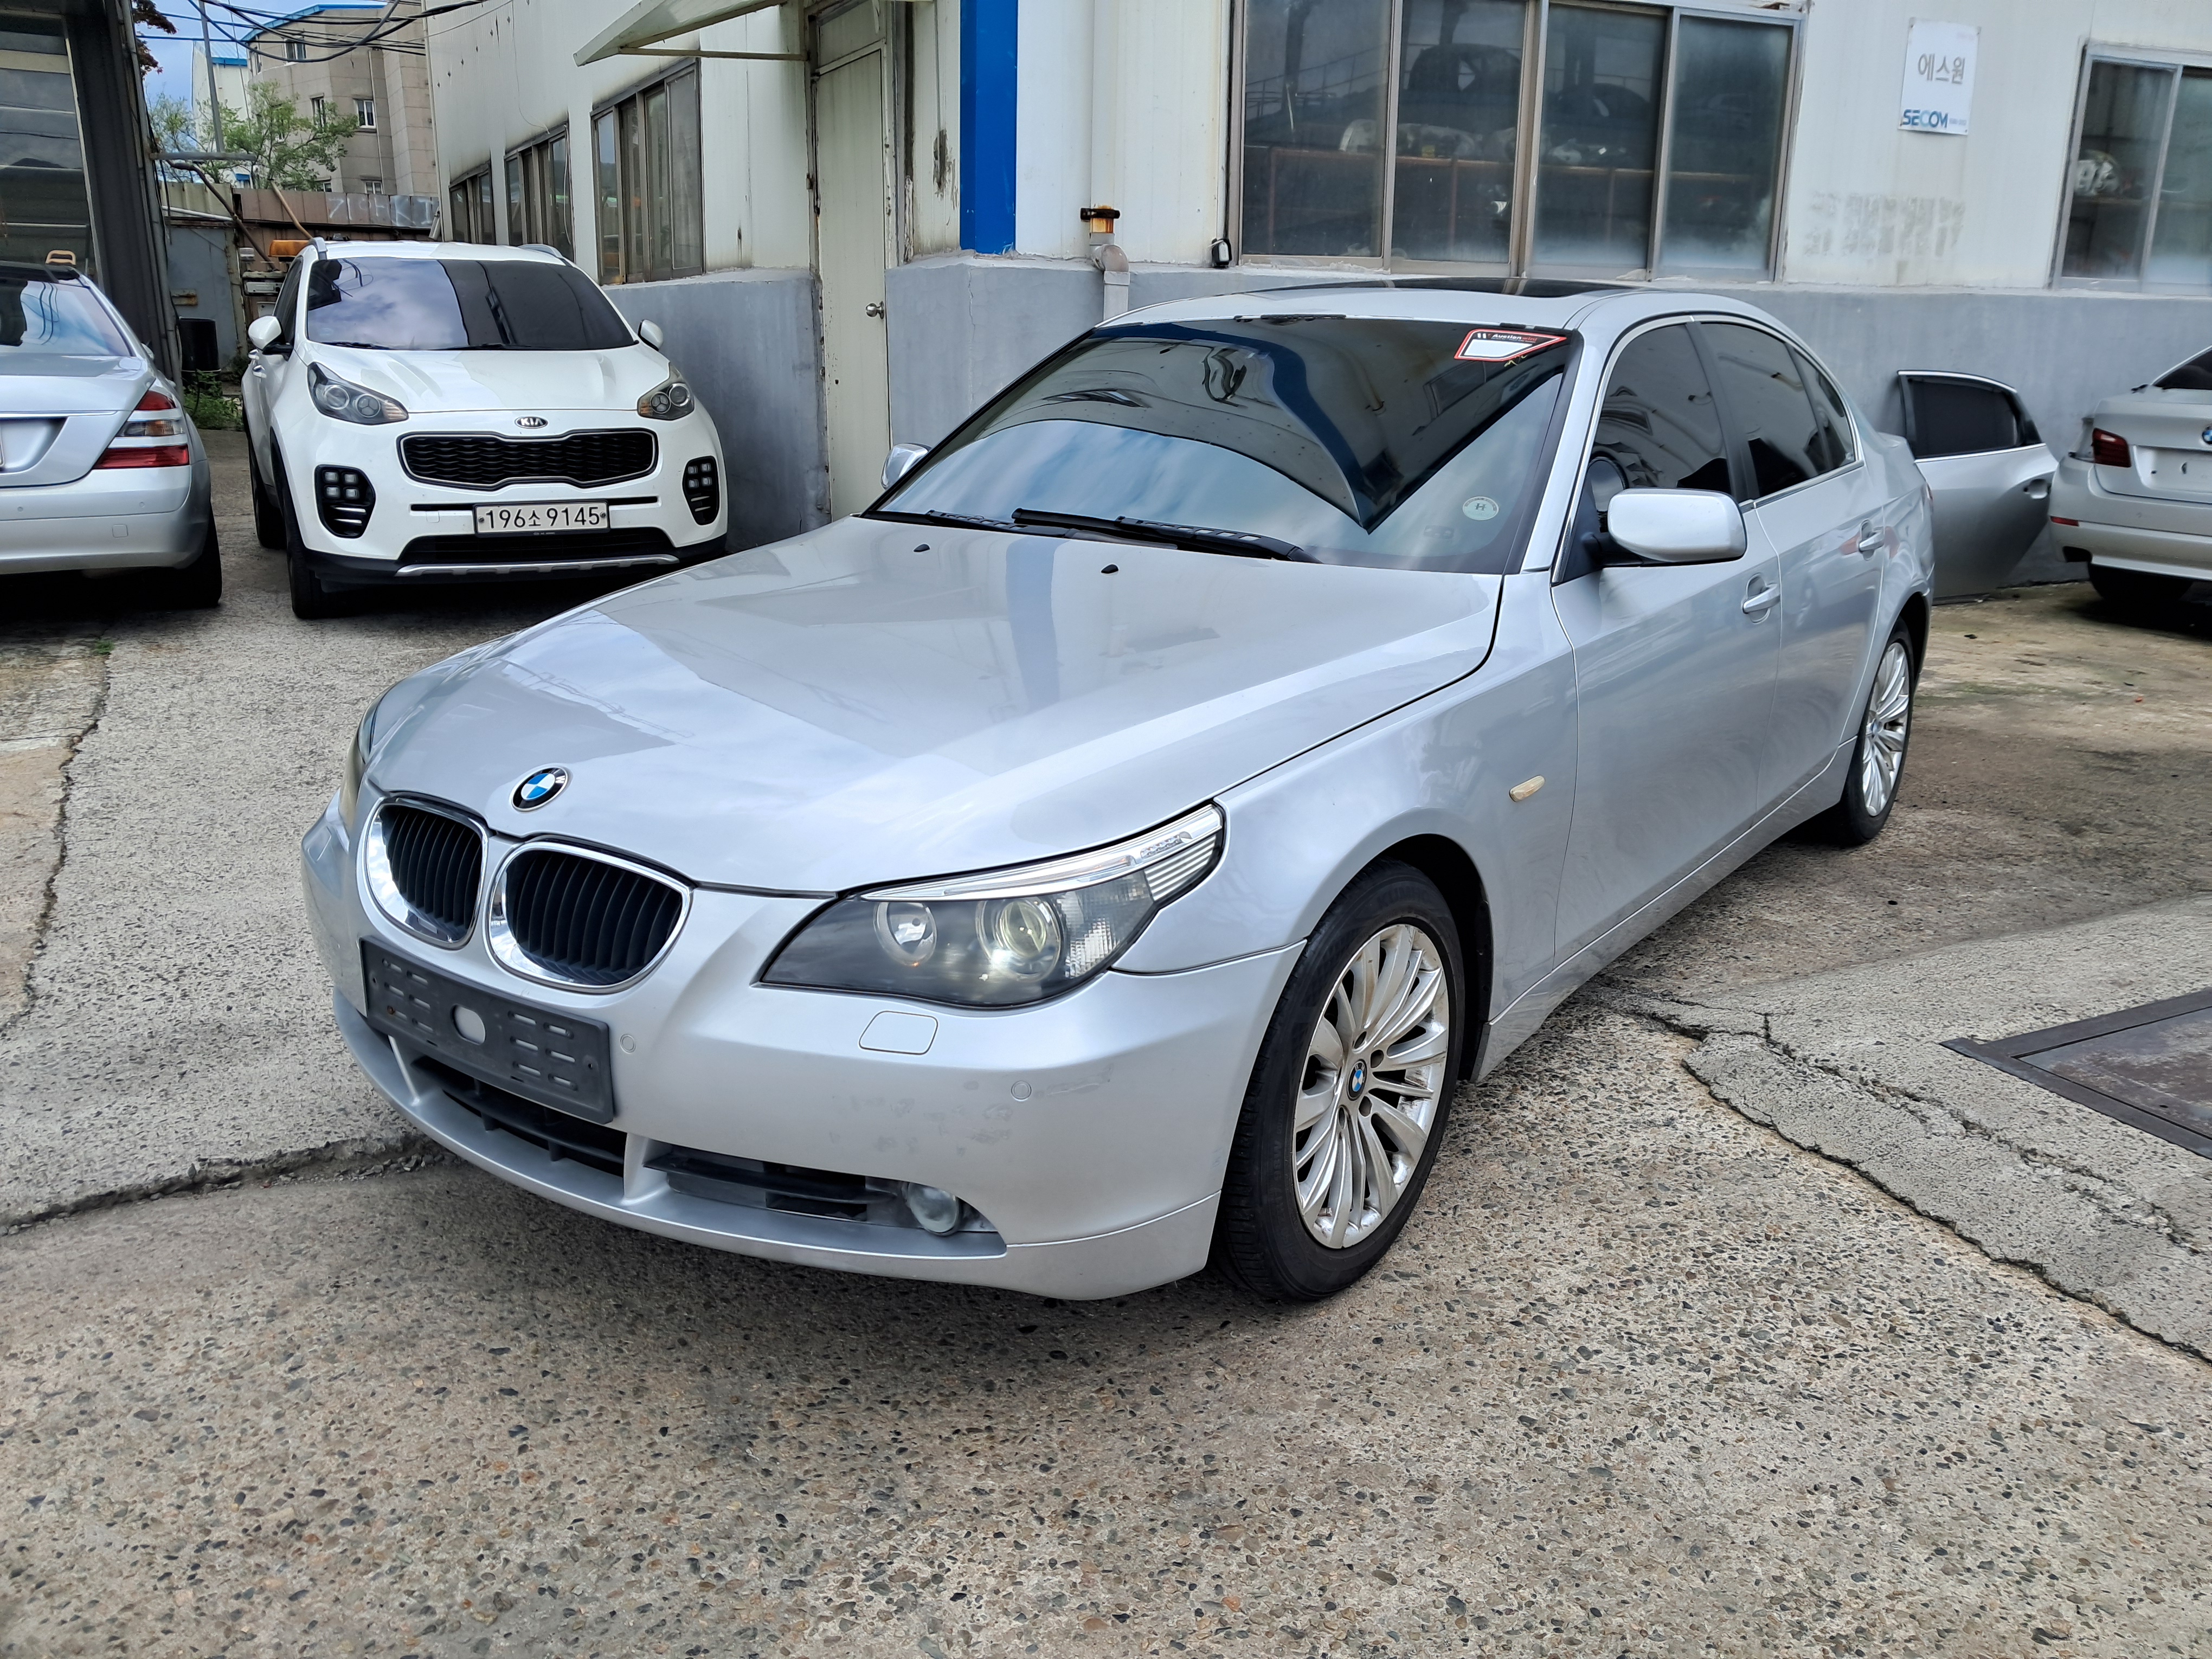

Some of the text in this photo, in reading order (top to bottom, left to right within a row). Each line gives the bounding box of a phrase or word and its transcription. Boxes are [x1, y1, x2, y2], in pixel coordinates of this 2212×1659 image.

[1918, 53, 1965, 85] 에스원
[1902, 109, 1948, 128] SECOM
[520, 417, 543, 426] KIA
[486, 506, 600, 529] 196소 9145
